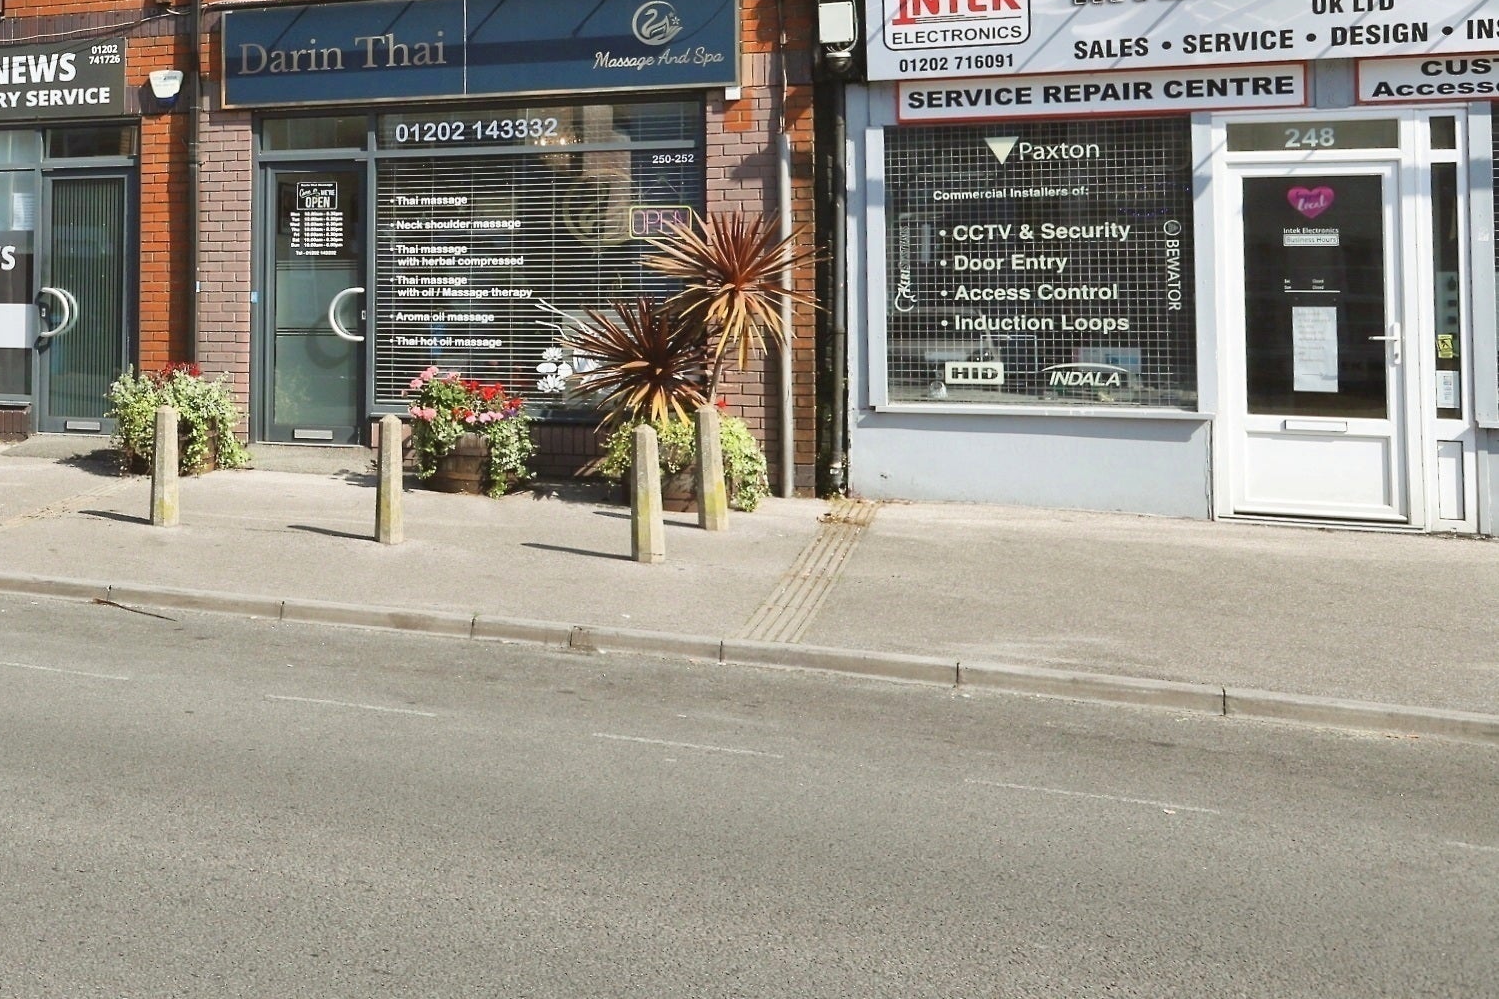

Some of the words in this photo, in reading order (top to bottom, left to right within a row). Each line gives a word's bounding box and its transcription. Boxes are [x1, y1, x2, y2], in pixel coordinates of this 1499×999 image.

[892, 25, 1022, 45] ELECTRONICS
[1074, 37, 1149, 60] SALES
[1183, 29, 1294, 54] SERVICE
[1331, 22, 1428, 47] DESIGN
[1467, 18, 1499, 40] IN
[91, 44, 118, 55] 01202
[237, 38, 345, 75] Darin
[354, 30, 447, 68] Thai
[593, 51, 655, 70] Massage
[657, 48, 690, 66] And
[693, 46, 724, 67] Spa
[88, 54, 121, 65] 741726
[899, 57, 949, 72] 01202
[955, 53, 1013, 70] 716091
[1421, 58, 1499, 77] CUS
[25, 87, 110, 107] SERVICE
[908, 86, 1032, 109] SERVICE
[1043, 81, 1154, 104] REPAIR
[1163, 75, 1294, 99] CENTRE
[1371, 81, 1499, 97] Access
[395, 121, 465, 143] 01202
[472, 118, 558, 139] 143332
[1284, 127, 1335, 148] 248
[652, 153, 694, 164] 250-252
[1019, 142, 1100, 161] Paxton
[396, 196, 418, 205] Thai
[420, 196, 467, 206] massage
[933, 188, 1007, 200] Commercial
[1010, 187, 1068, 198] Installers
[1072, 185, 1089, 196] of:
[305, 196, 331, 208] OPEN
[396, 220, 422, 229] Neck
[424, 219, 472, 229] shoulder
[473, 220, 521, 230] massage
[952, 224, 1012, 241] CCTV
[1019, 224, 1034, 240] &
[1041, 222, 1131, 242] Security
[396, 245, 418, 254] Thai
[420, 246, 467, 255] massage
[397, 257, 419, 266] with
[421, 256, 455, 266] herbal
[457, 256, 524, 267] compressed
[954, 255, 1004, 271] Door
[1011, 254, 1068, 273] Entry
[396, 276, 418, 285] Thai
[420, 277, 467, 286] massage
[1166, 239, 1182, 310] BEWATOR
[397, 288, 419, 297] with
[421, 288, 435, 297] oil
[442, 288, 490, 298] Massage
[491, 288, 533, 298] therapy
[954, 284, 1031, 301] Access
[1037, 283, 1119, 301] Control
[396, 312, 431, 321] Aroma
[433, 312, 444, 321] oil
[447, 313, 495, 323] massage
[955, 314, 1053, 331] Induction
[1061, 314, 1129, 334] Loops
[396, 336, 418, 346] Thai
[420, 337, 438, 346] hot
[440, 337, 452, 346] oil
[454, 338, 502, 348] massage
[951, 367, 999, 380] HID
[1049, 371, 1121, 386] INDALA
